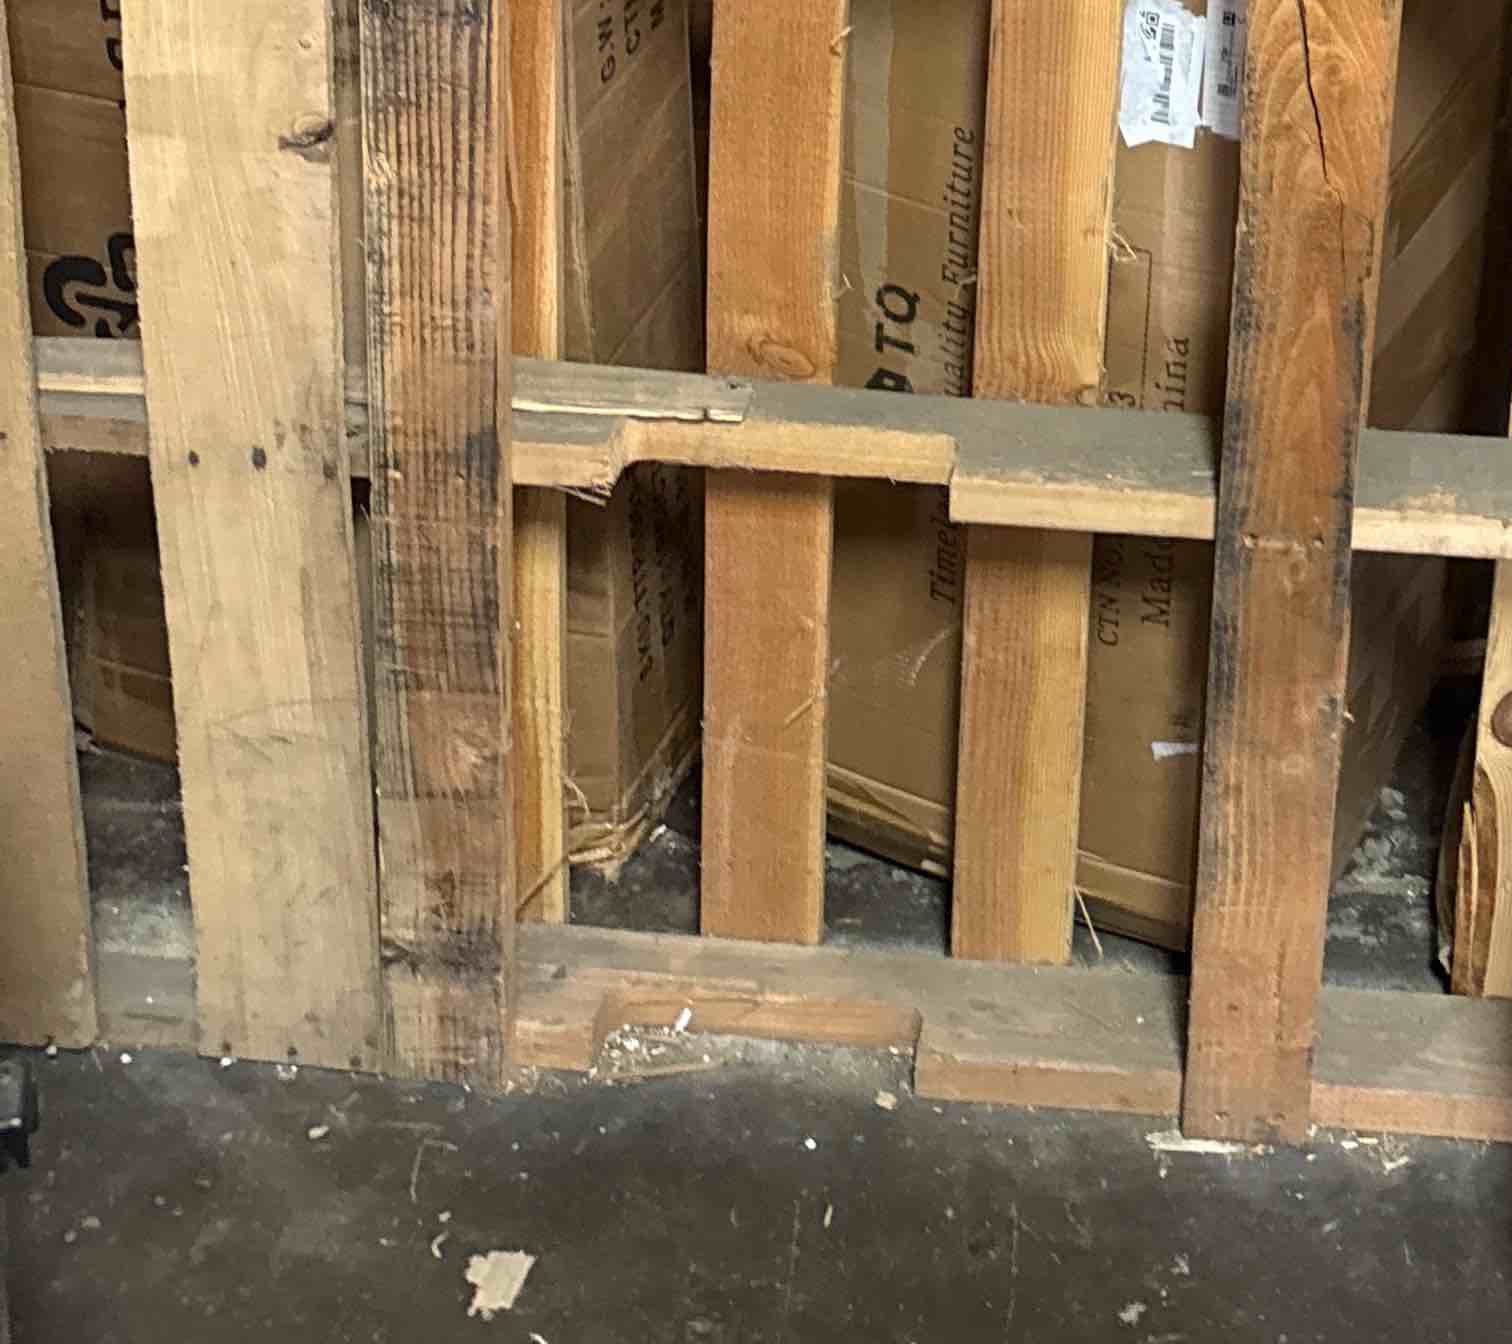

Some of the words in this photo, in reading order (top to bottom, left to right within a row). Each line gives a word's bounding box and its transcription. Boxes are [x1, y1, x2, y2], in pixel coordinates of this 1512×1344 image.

[941, 124, 976, 292] Furniture
[873, 282, 922, 356] TQ
[941, 298, 974, 398] uality
[928, 496, 958, 606] Timel
